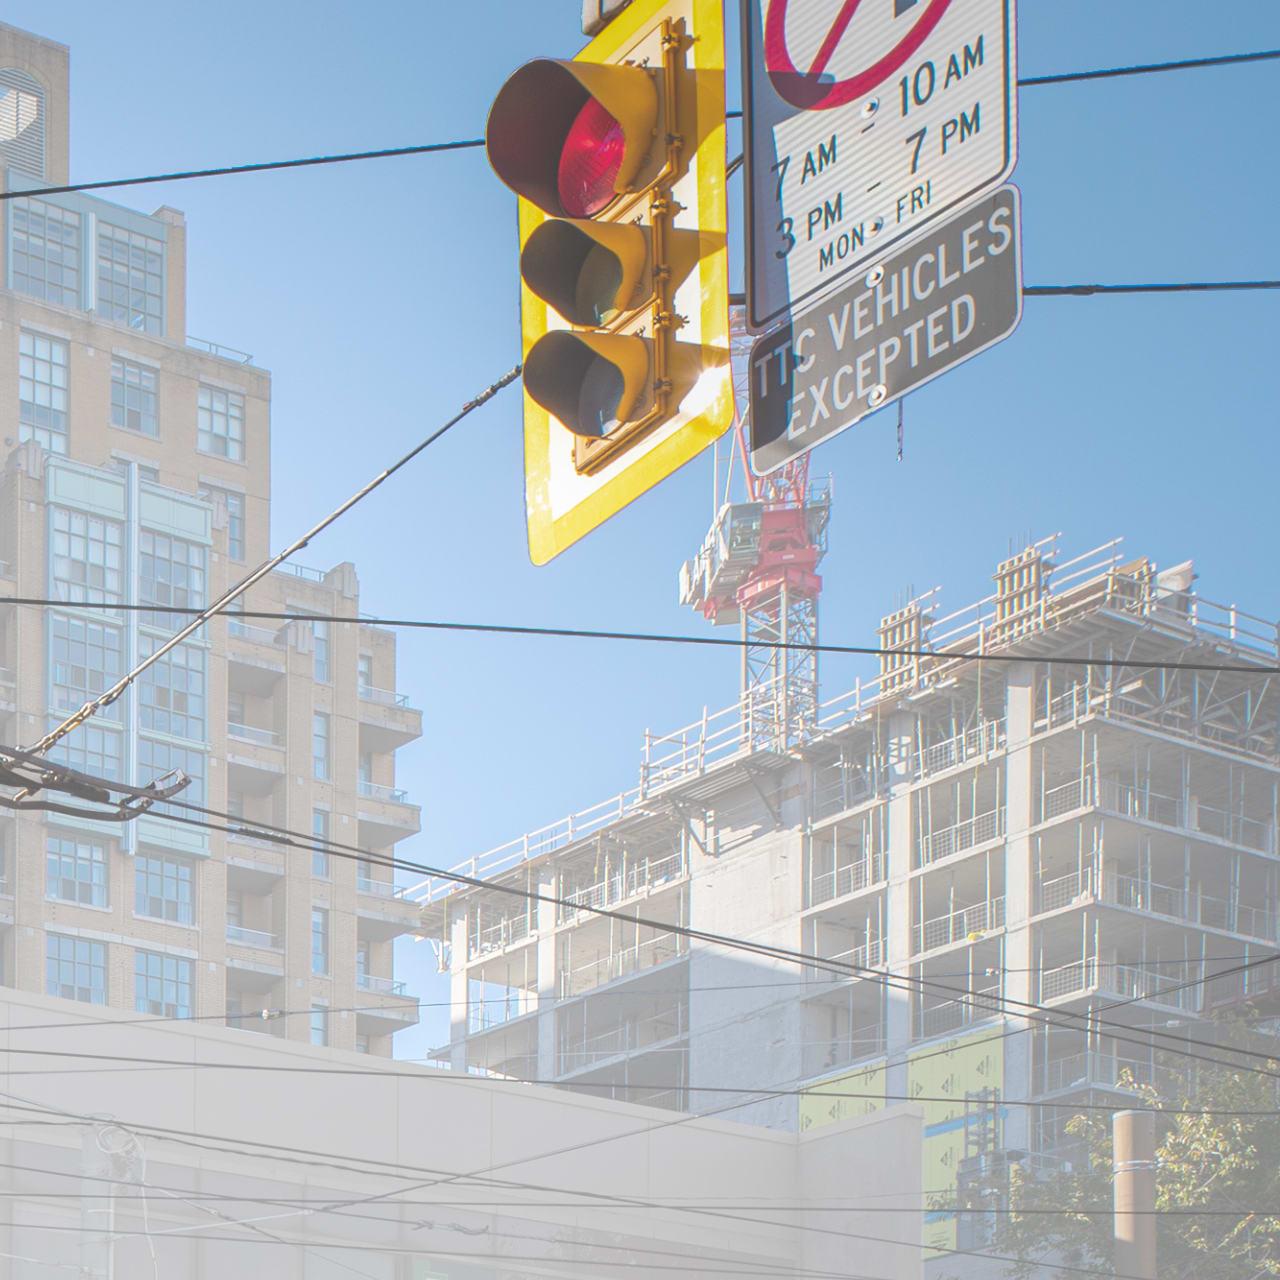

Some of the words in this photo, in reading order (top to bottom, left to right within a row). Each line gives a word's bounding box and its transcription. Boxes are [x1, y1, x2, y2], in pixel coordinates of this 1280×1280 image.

[770, 155, 791, 202] 7
[800, 133, 838, 186] AM
[898, 60, 937, 118] 10
[943, 33, 985, 91] AM
[775, 216, 796, 260] 3
[807, 191, 843, 242] PM
[904, 126, 928, 175] 7
[940, 101, 982, 156] PM
[753, 327, 817, 400] TTC
[827, 205, 1013, 353] VEHICLES
[818, 222, 866, 273] MON
[896, 179, 932, 225] FRI
[787, 293, 977, 442] EXCEPTED
